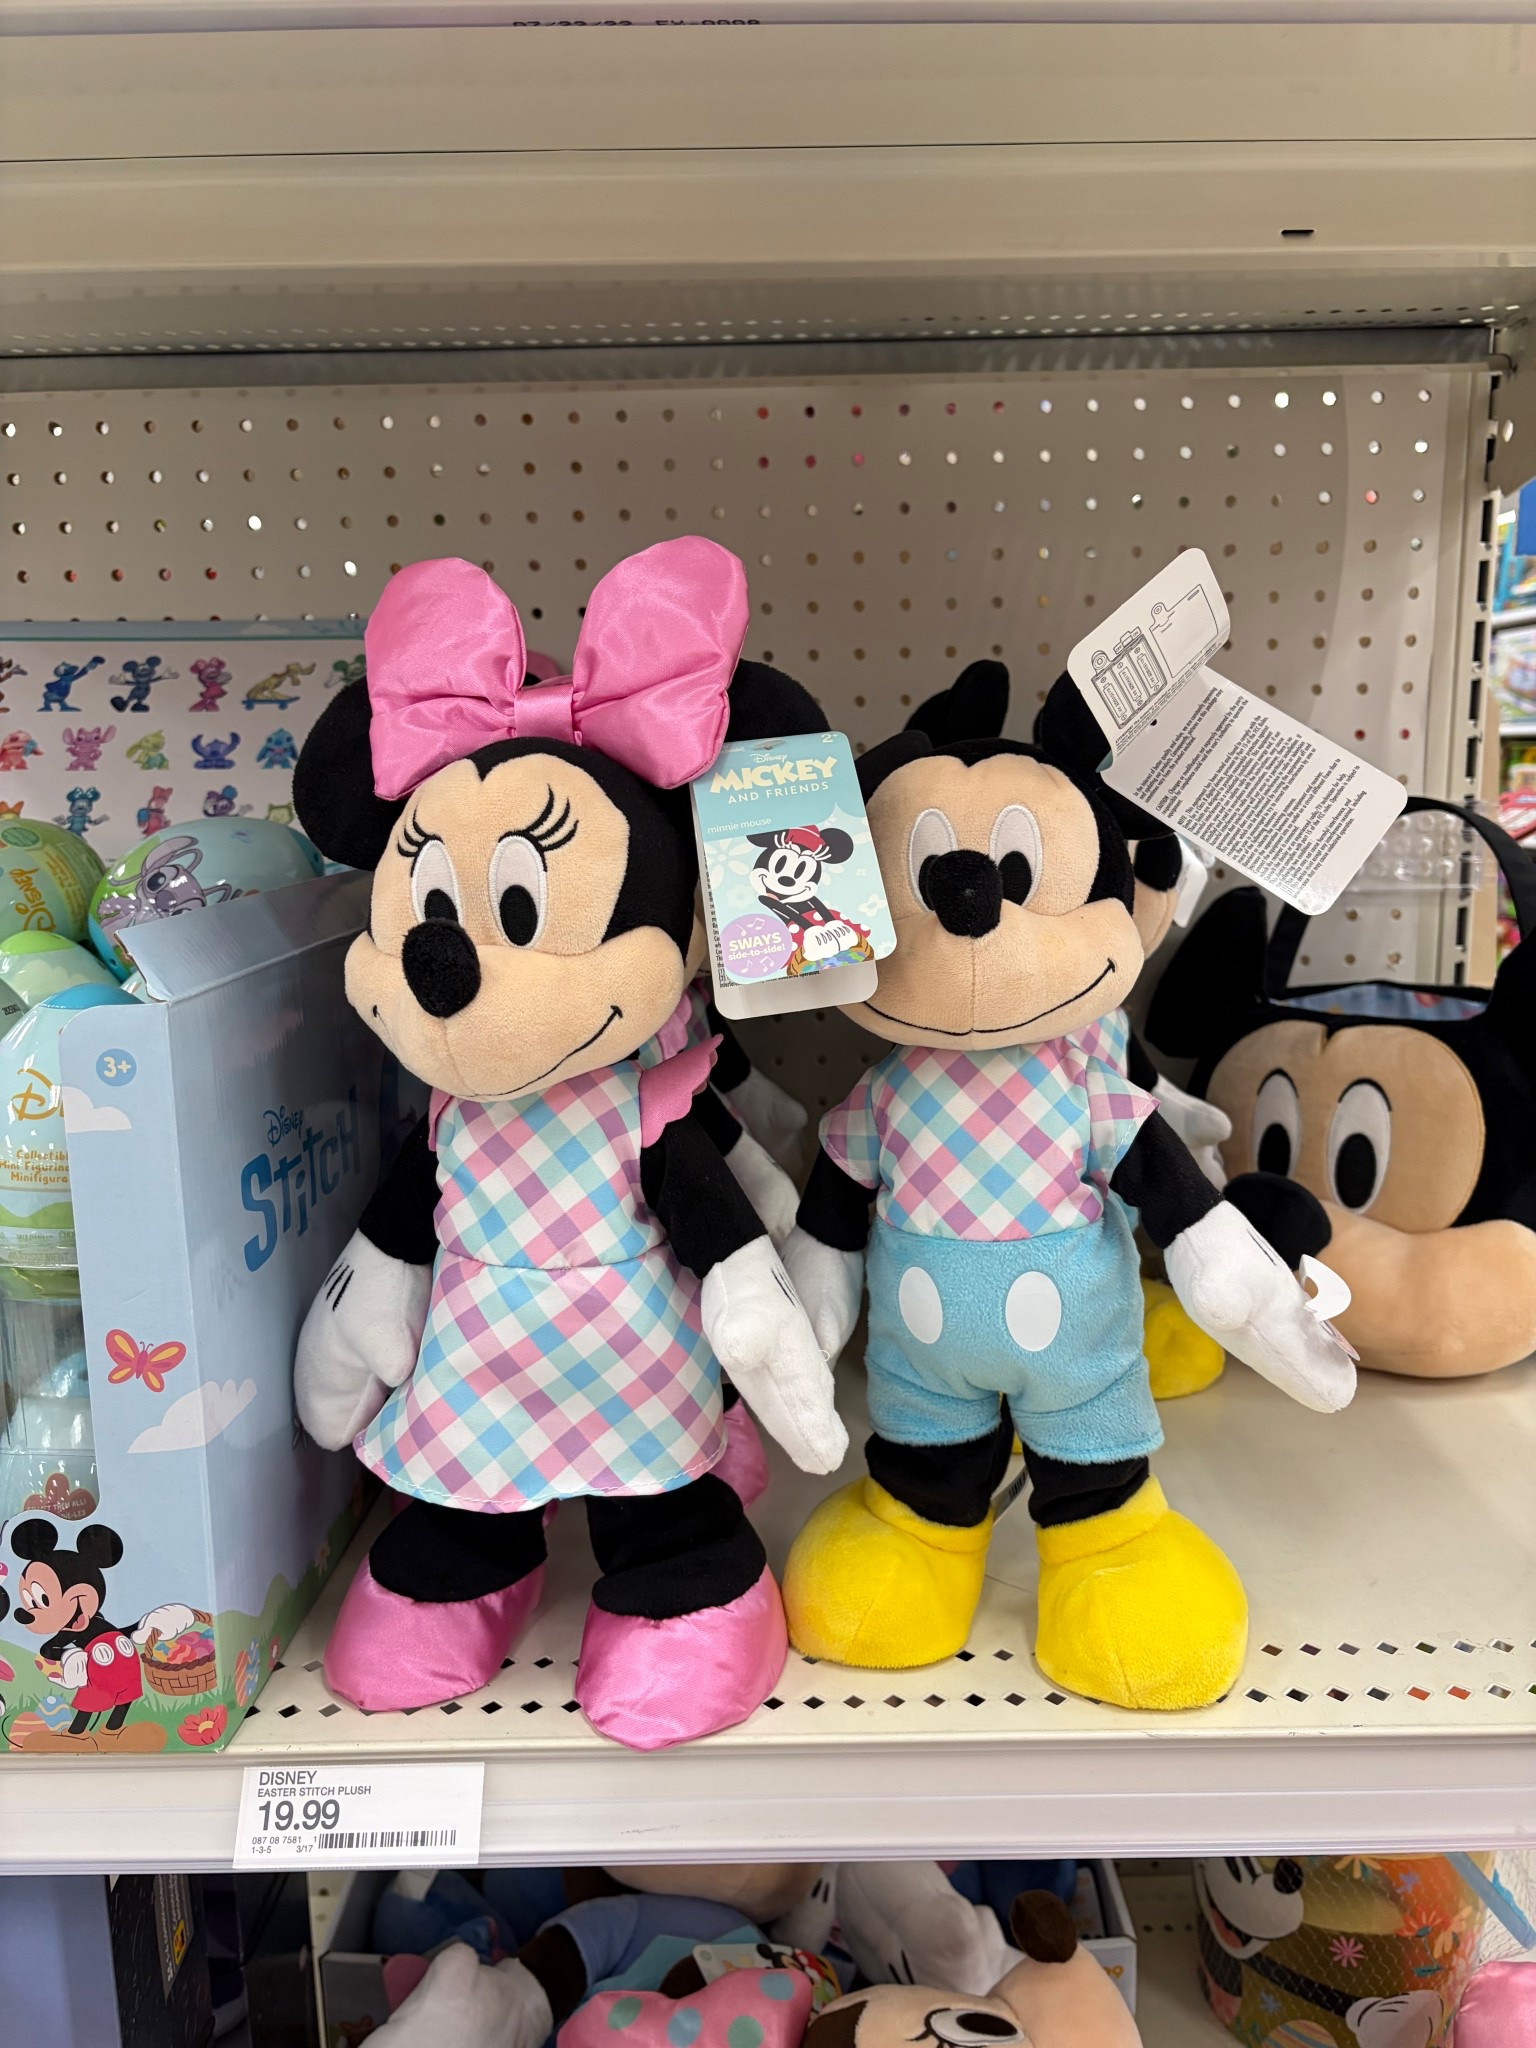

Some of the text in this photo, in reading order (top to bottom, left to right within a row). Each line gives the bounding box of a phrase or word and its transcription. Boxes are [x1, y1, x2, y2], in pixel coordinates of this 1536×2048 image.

[710, 756, 838, 793] MICKEY
[728, 781, 829, 805] AND FRIENDS
[707, 817, 772, 834] minnie mouse
[728, 932, 782, 952] SWAYS
[728, 943, 786, 962] side-to-side!
[103, 1056, 132, 1078] 3+
[259, 1770, 318, 1786] DISNEY
[257, 1785, 372, 1798] EASTER STITCH PLUSH
[258, 1799, 340, 1831] 19.99
[251, 1844, 314, 1854] 1-3-5 3/17
[252, 1836, 268, 1845] 087
[270, 1836, 280, 1845] 08
[282, 1835, 302, 1844] 7581
